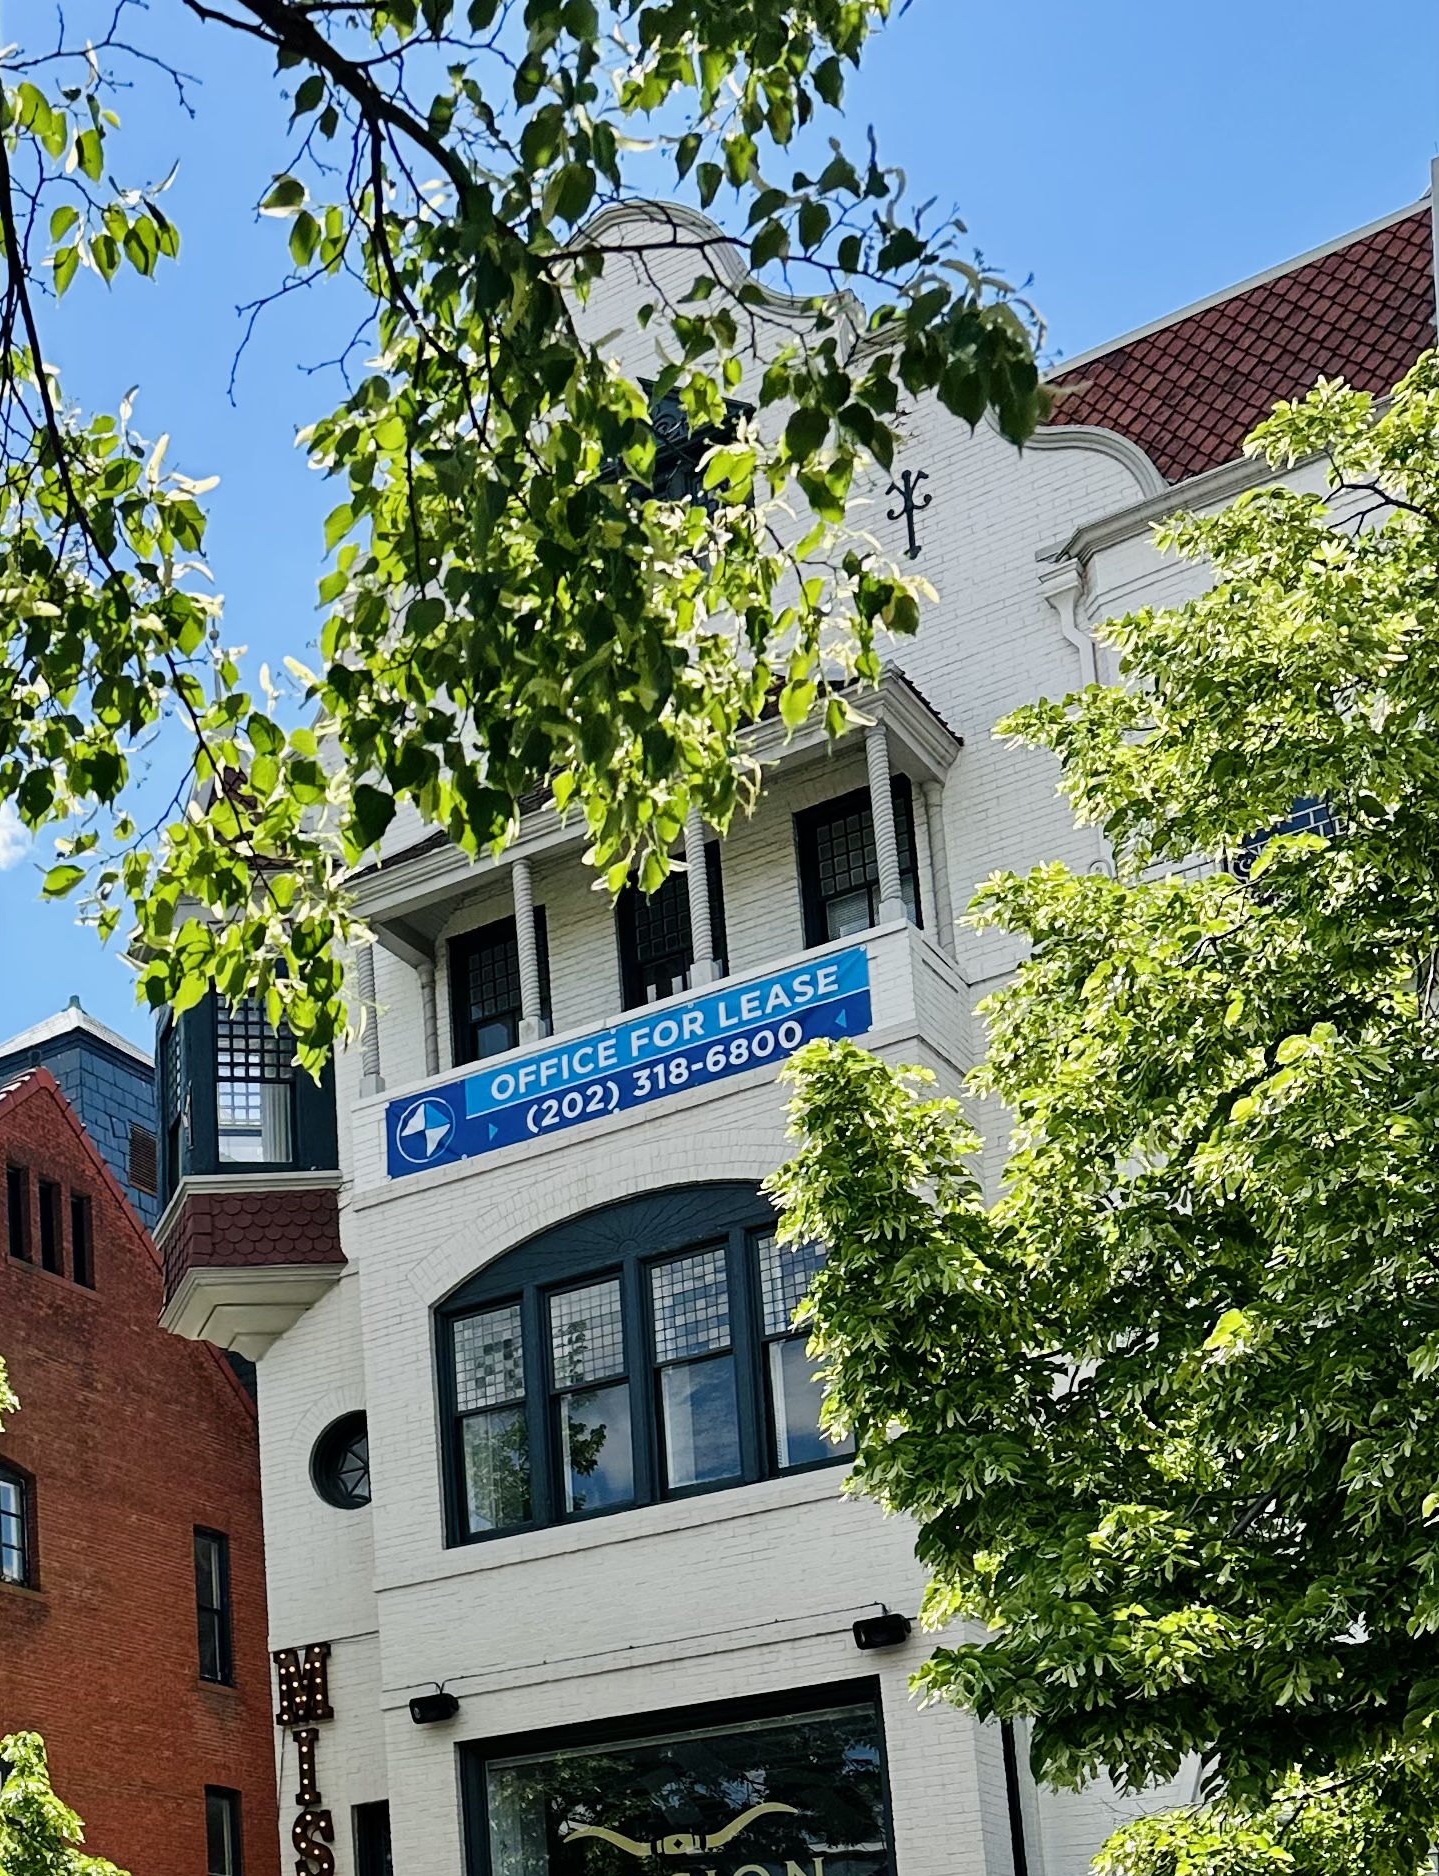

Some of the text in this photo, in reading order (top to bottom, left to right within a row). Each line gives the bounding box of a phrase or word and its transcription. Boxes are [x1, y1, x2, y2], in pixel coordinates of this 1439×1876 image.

[490, 965, 840, 1102] OFFICE FOR LEASE
[526, 1020, 803, 1135] (202) 318-6800
